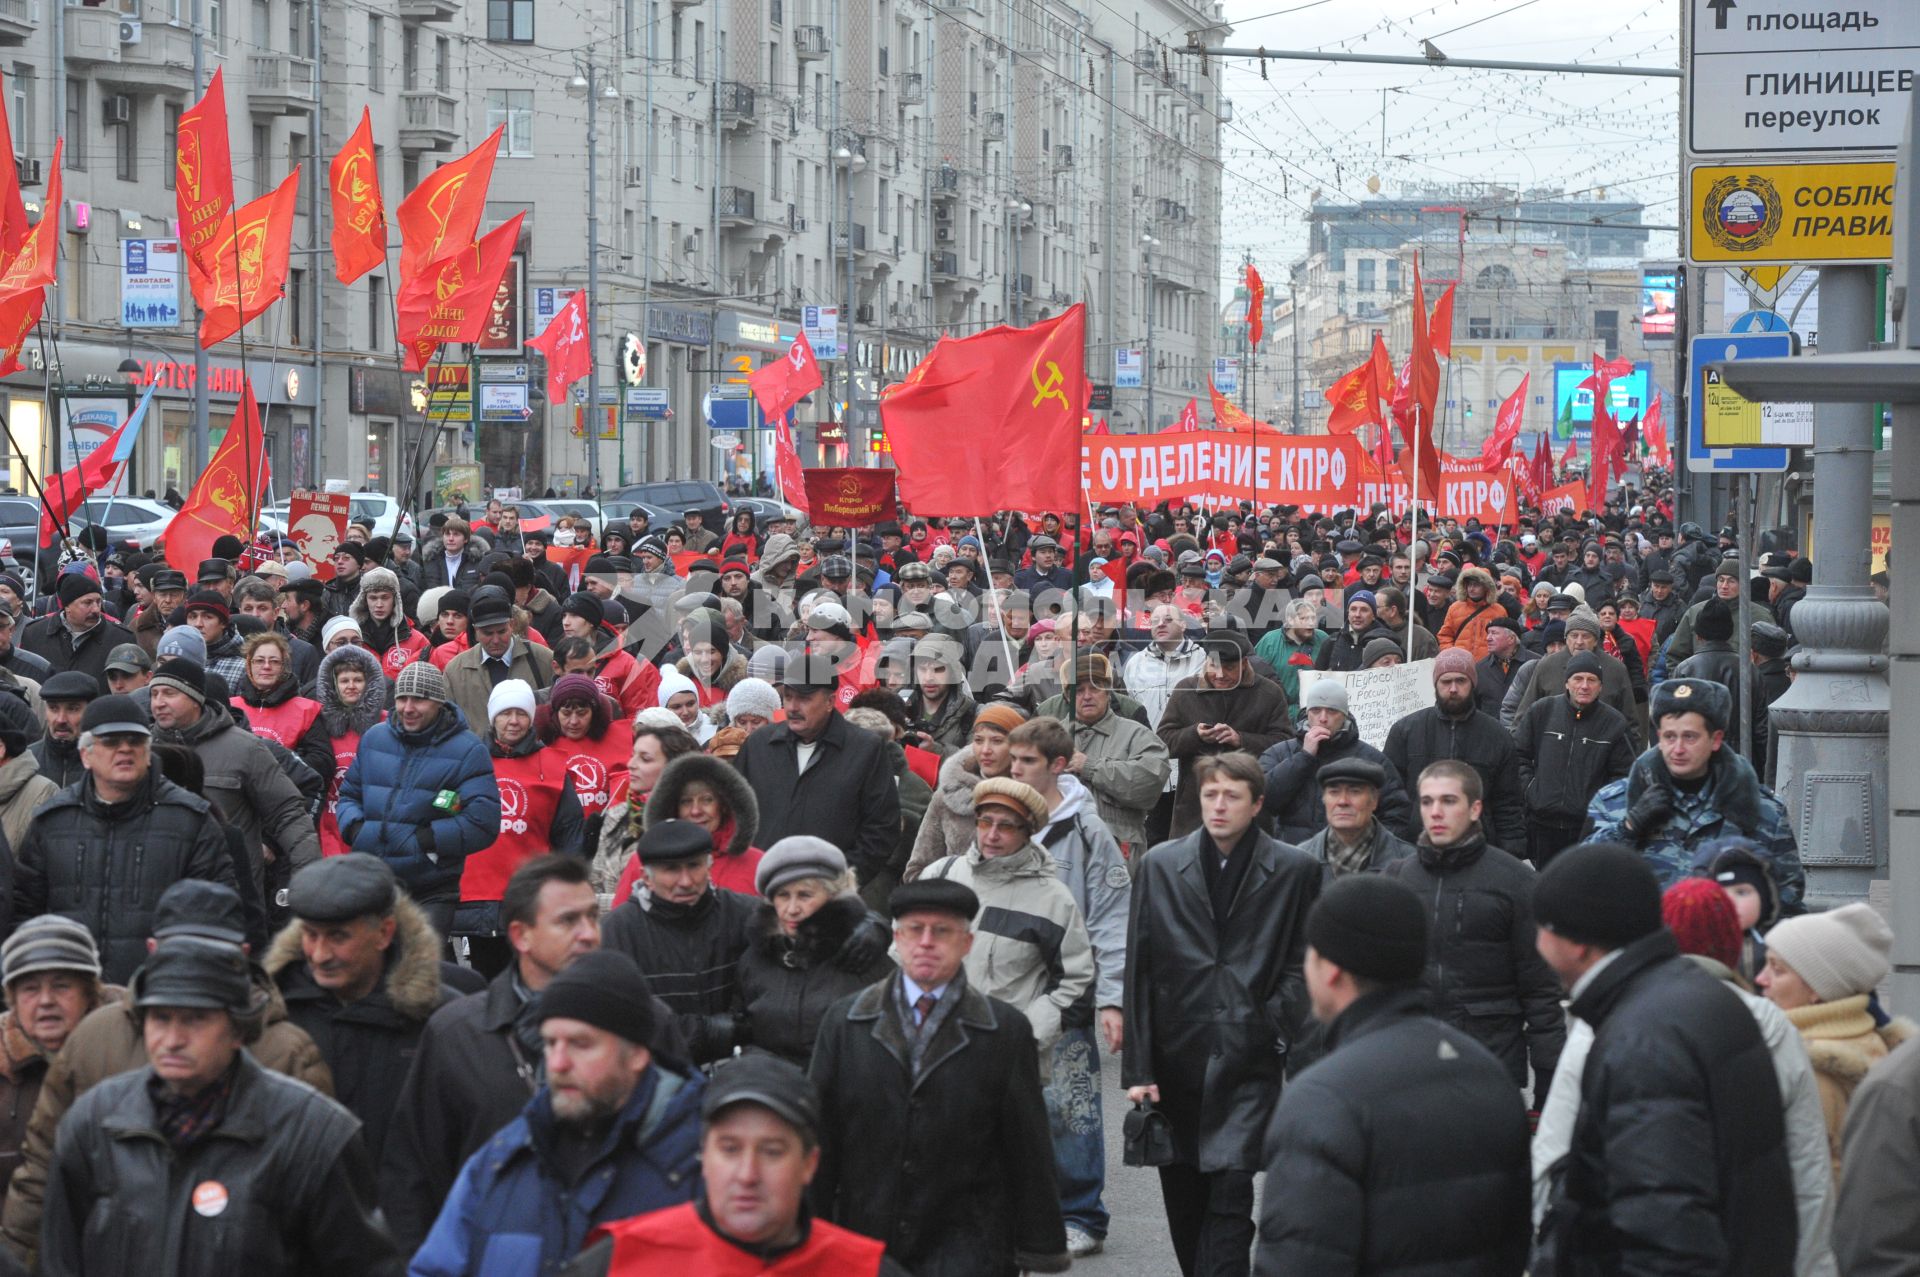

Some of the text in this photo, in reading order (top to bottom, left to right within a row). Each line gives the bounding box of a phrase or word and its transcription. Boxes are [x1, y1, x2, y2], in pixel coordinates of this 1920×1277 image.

[1747, 11, 1879, 32] площадь
[1745, 109, 1881, 131] переулок
[1792, 215, 1892, 237] ПРАВИ
[1101, 441, 1271, 497] ОТДЕЛЕНИЕ
[1280, 447, 1347, 491] КПРФ
[292, 491, 313, 501] ЛЕНИН
[1446, 480, 1506, 516] КПРФ
[310, 502, 331, 513] ЛЕНИН
